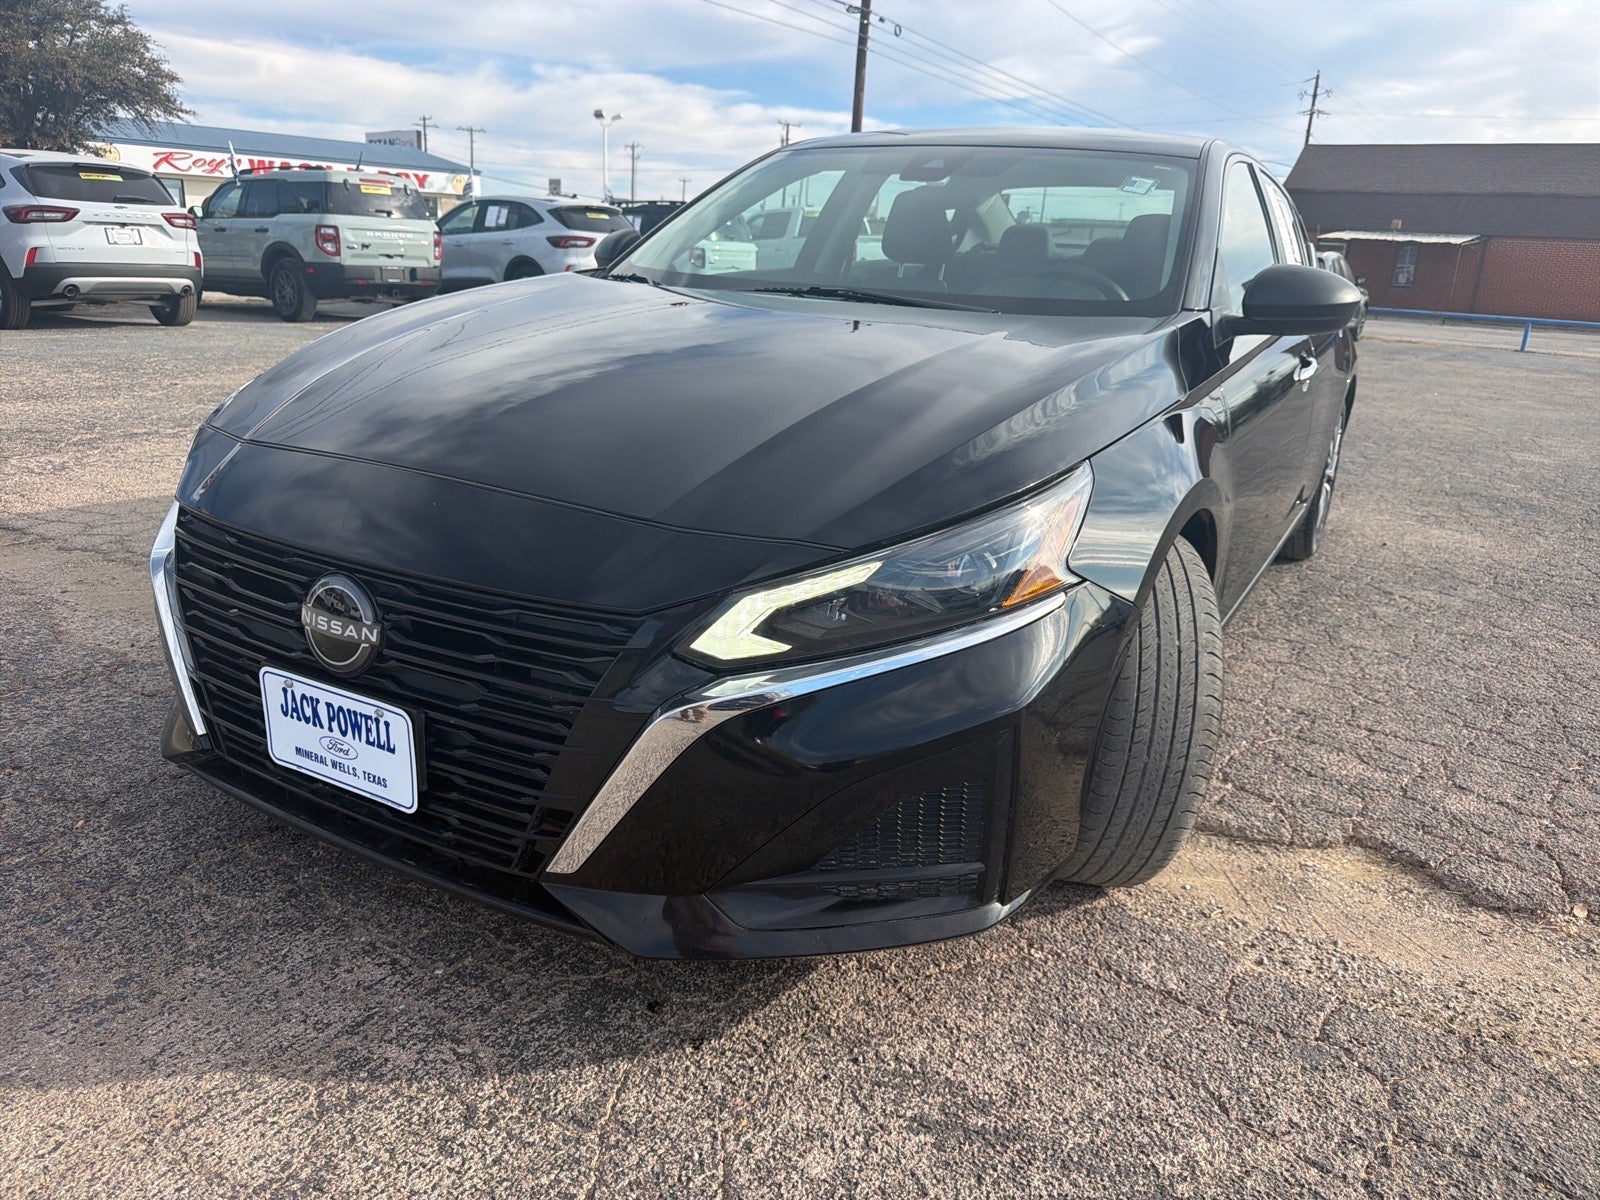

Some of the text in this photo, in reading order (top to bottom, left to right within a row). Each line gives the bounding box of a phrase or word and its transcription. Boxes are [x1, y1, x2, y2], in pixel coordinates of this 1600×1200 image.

[301, 607, 378, 642] NISSAN
[280, 686, 396, 755] JACK POWELL
[295, 746, 388, 788] MINERAL WELLS, TEXAS
[327, 739, 351, 757] Ford
